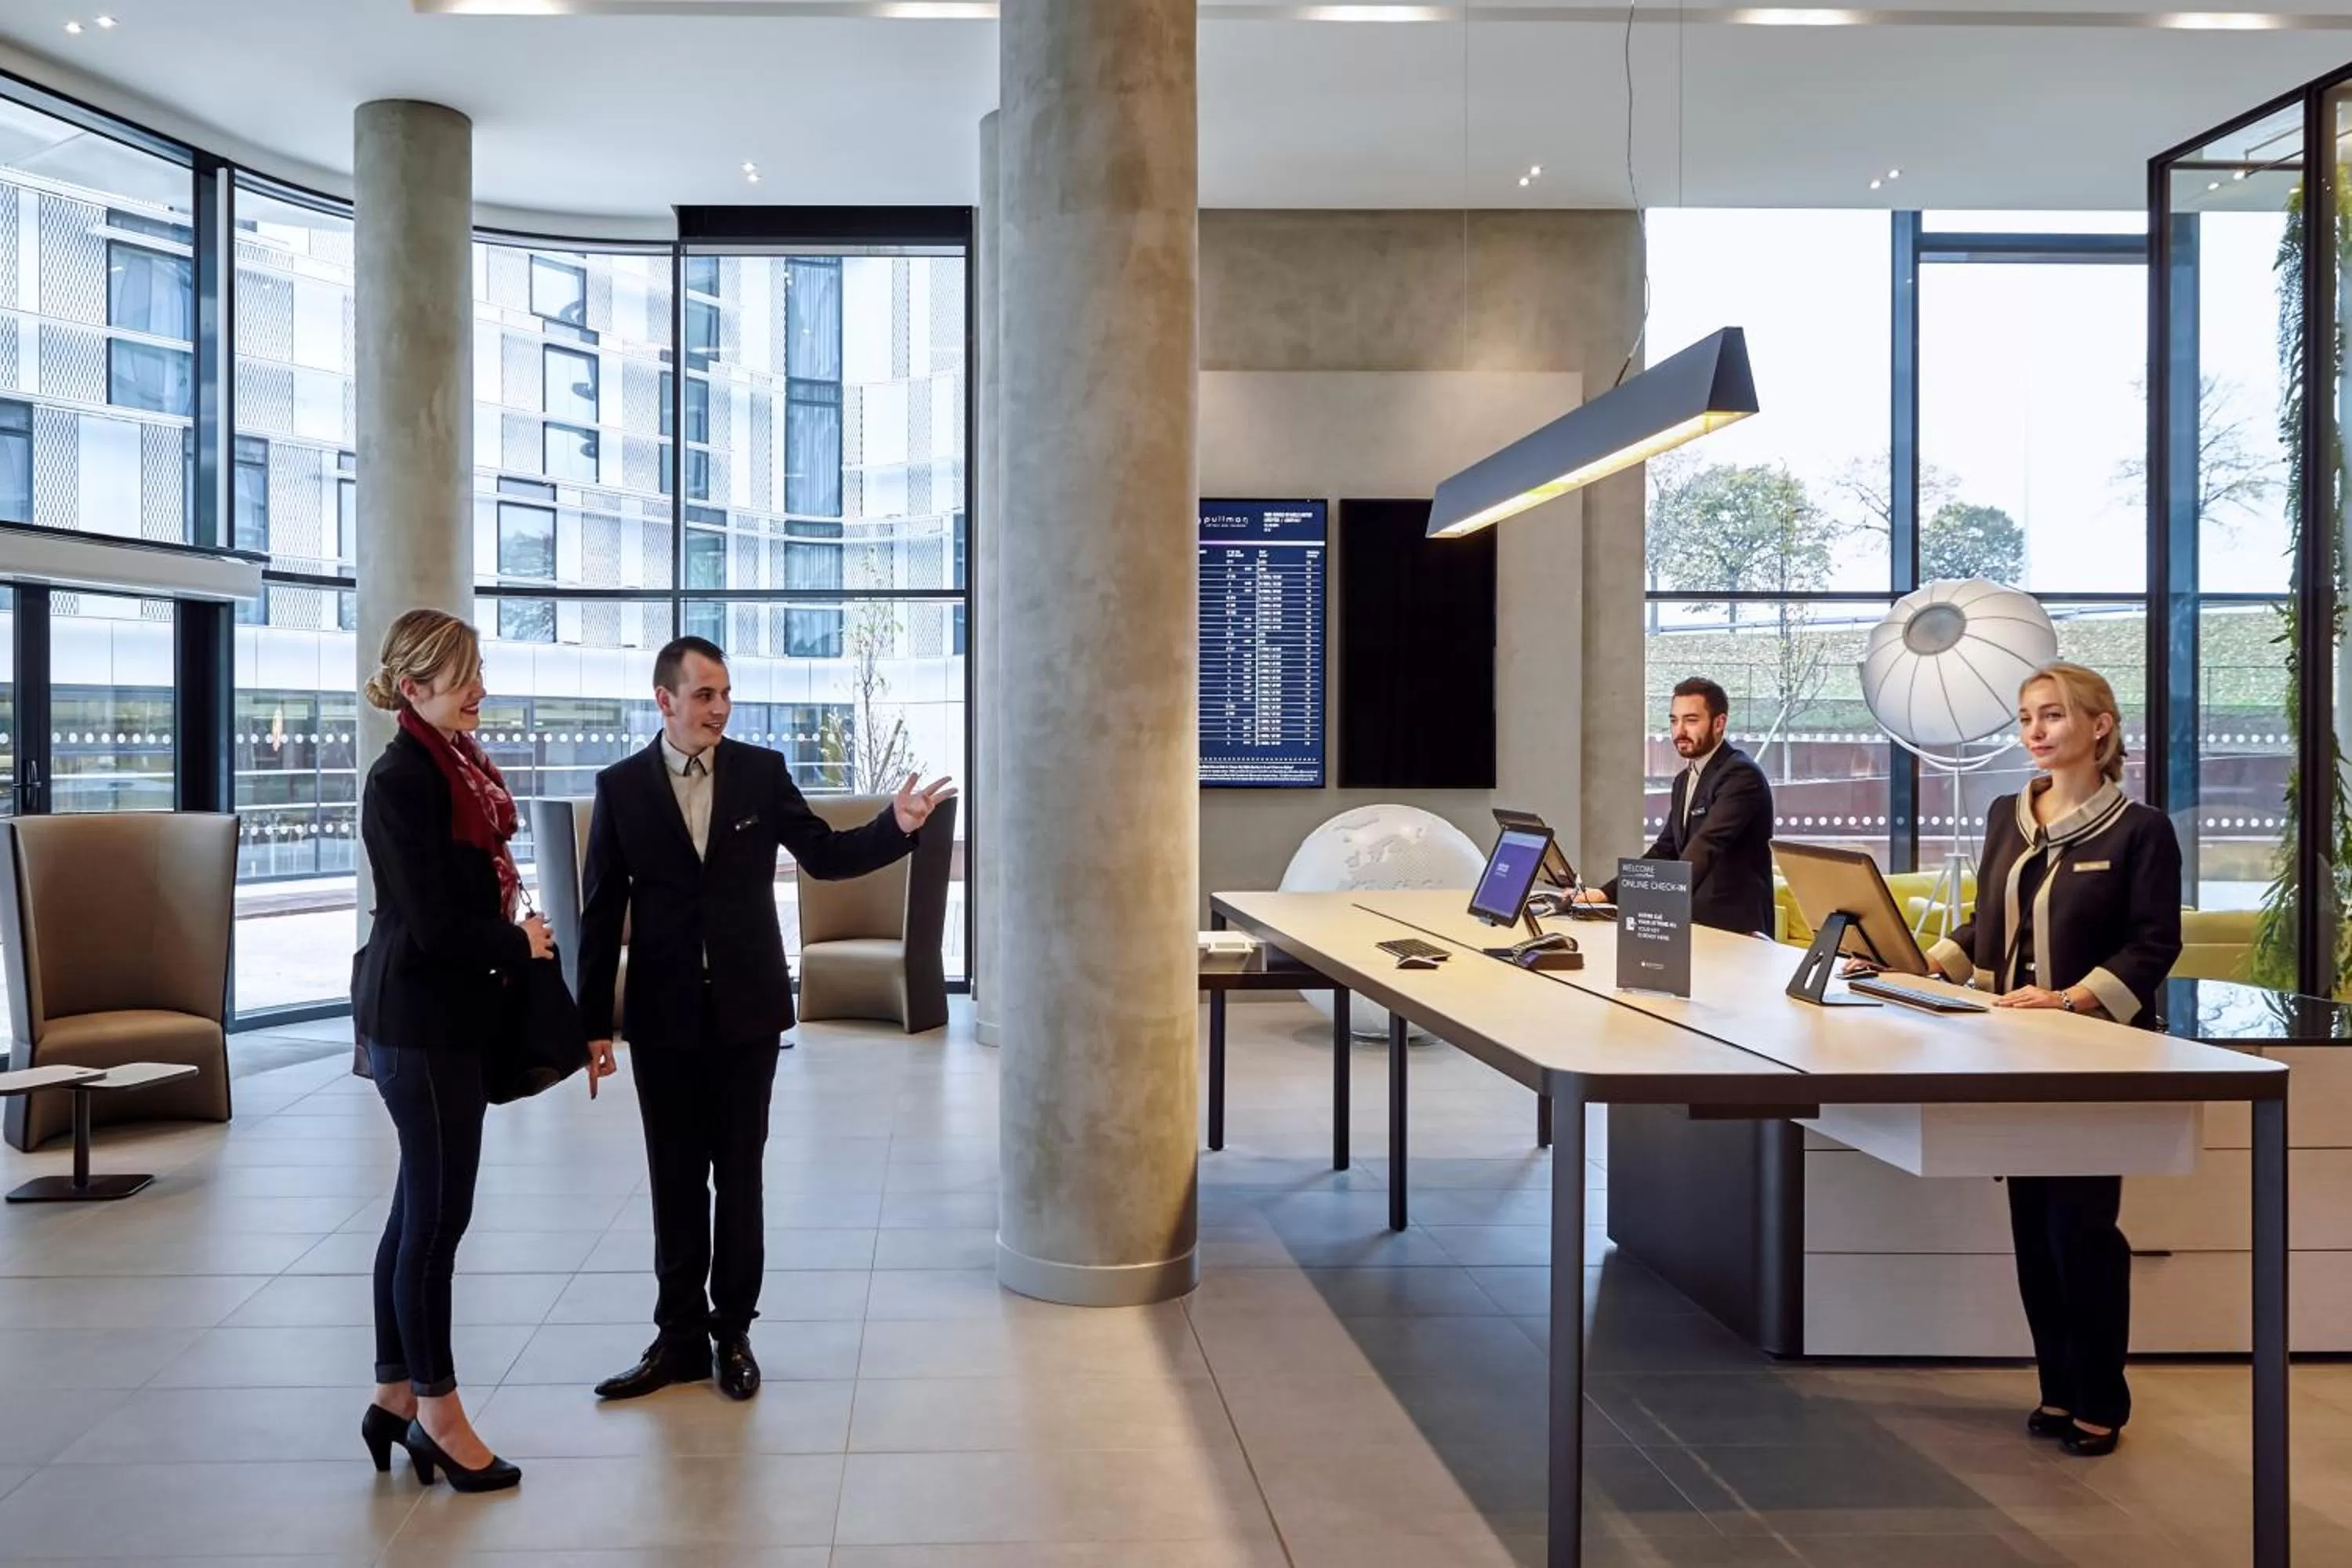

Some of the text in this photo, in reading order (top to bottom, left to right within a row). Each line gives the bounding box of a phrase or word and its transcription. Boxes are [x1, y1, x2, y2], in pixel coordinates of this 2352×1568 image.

[1203, 515, 1248, 524] pullman
[1622, 863, 1656, 873] WELCOME
[1621, 878, 1686, 891] ONLINE CHECK-IN
